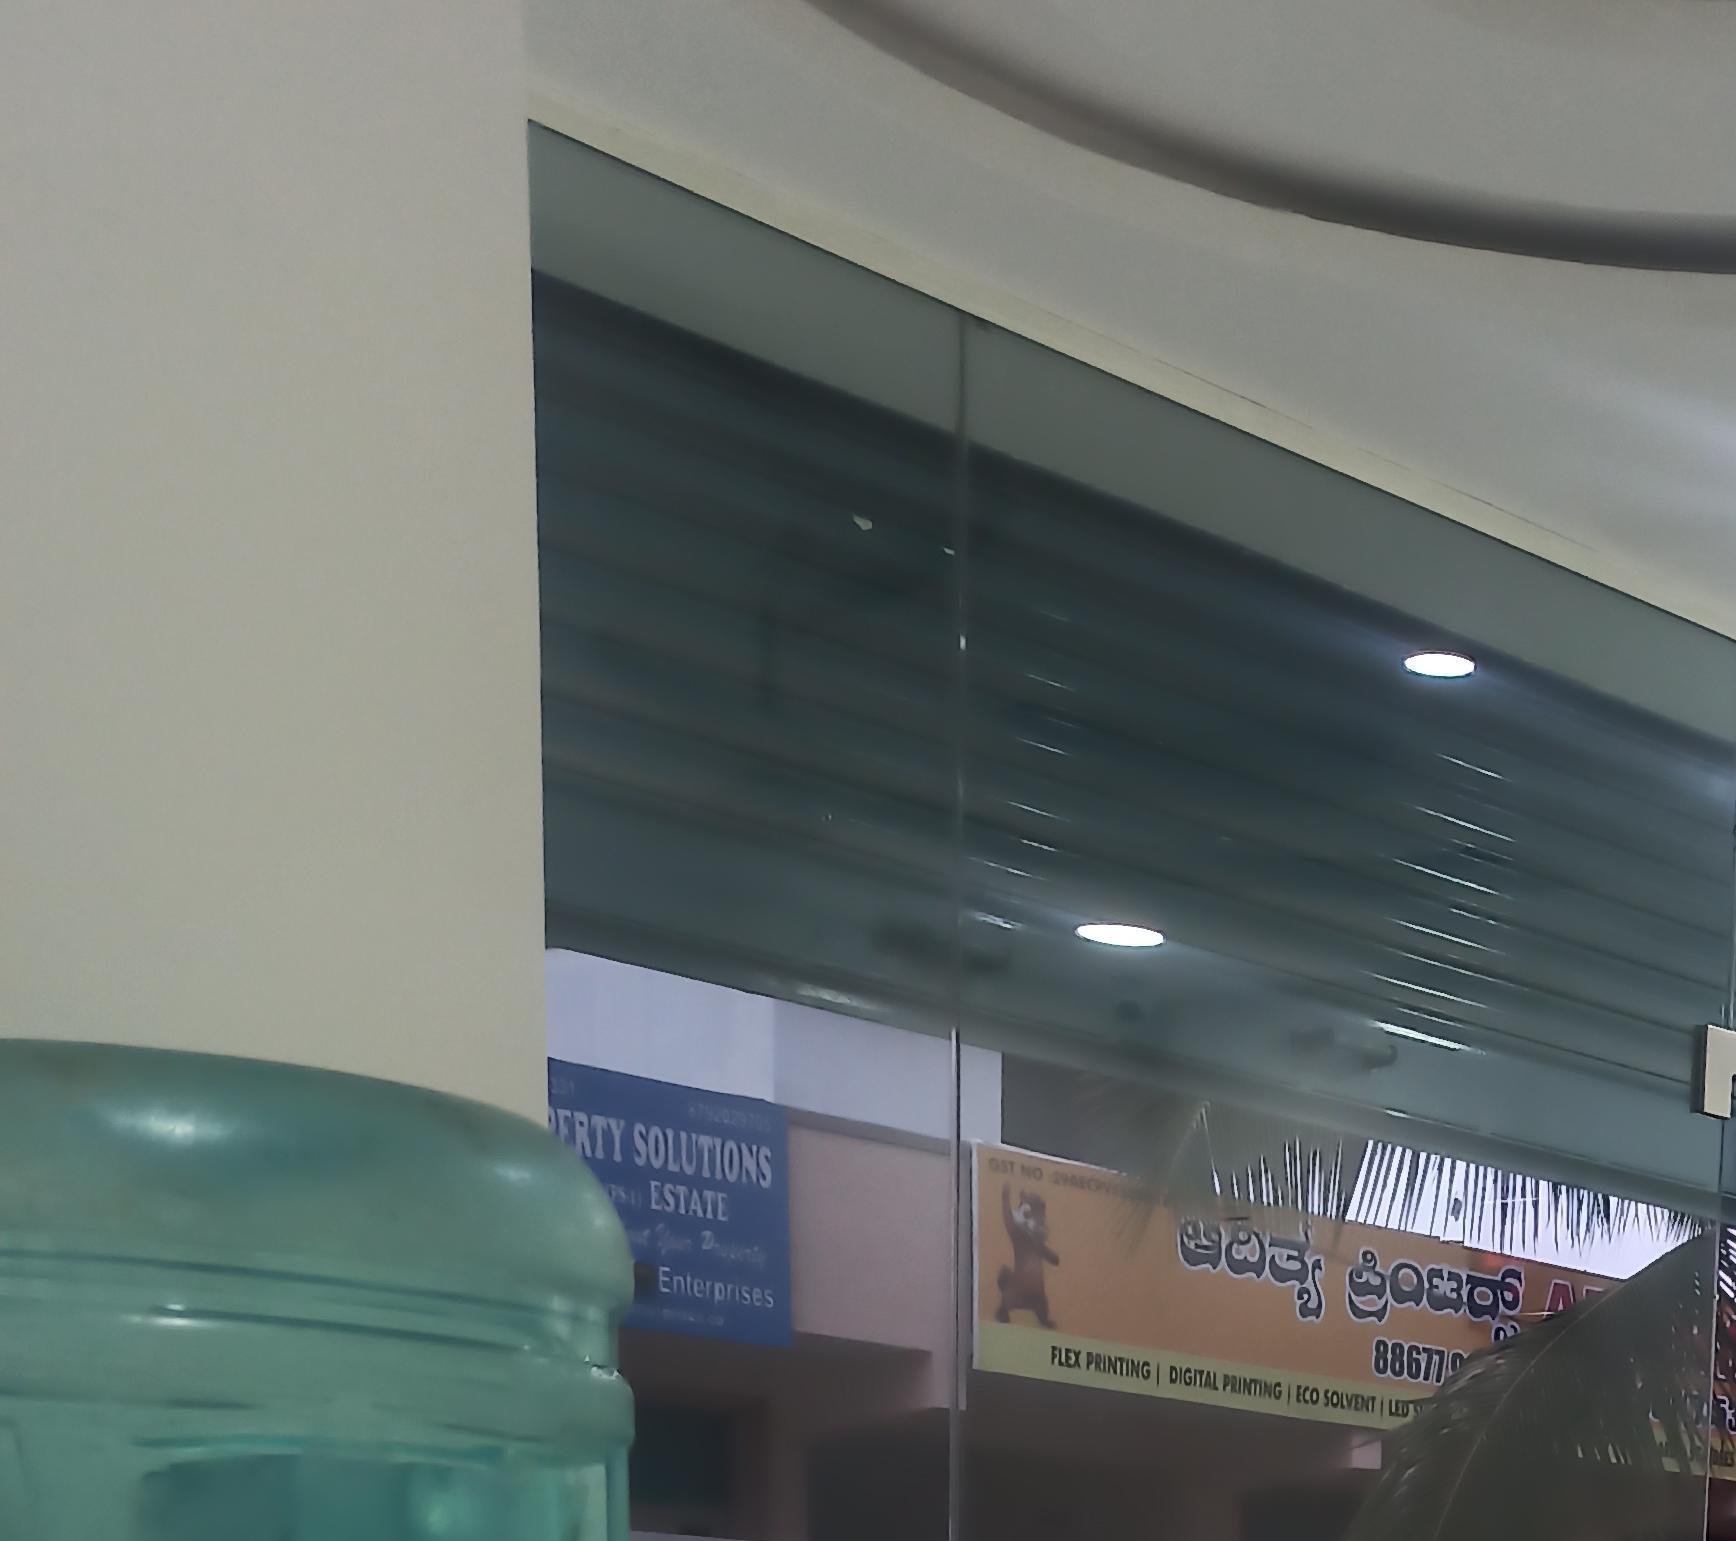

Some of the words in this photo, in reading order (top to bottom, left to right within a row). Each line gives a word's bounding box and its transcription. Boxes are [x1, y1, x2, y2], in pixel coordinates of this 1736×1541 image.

[633, 1123, 772, 1189] SOLUTIONS
[650, 1180, 729, 1221] ESTATE
[658, 1266, 774, 1308] Enterprises
[1051, 1346, 1082, 1369] FLEX
[1087, 1352, 1151, 1380] PRINTING
[1170, 1365, 1218, 1391] DIGITAL
[1223, 1374, 1282, 1401] PRINTING
[1296, 1385, 1319, 1406] ECO
[1324, 1389, 1376, 1413] SOLVENT
[1373, 1338, 1446, 1385] 88677
